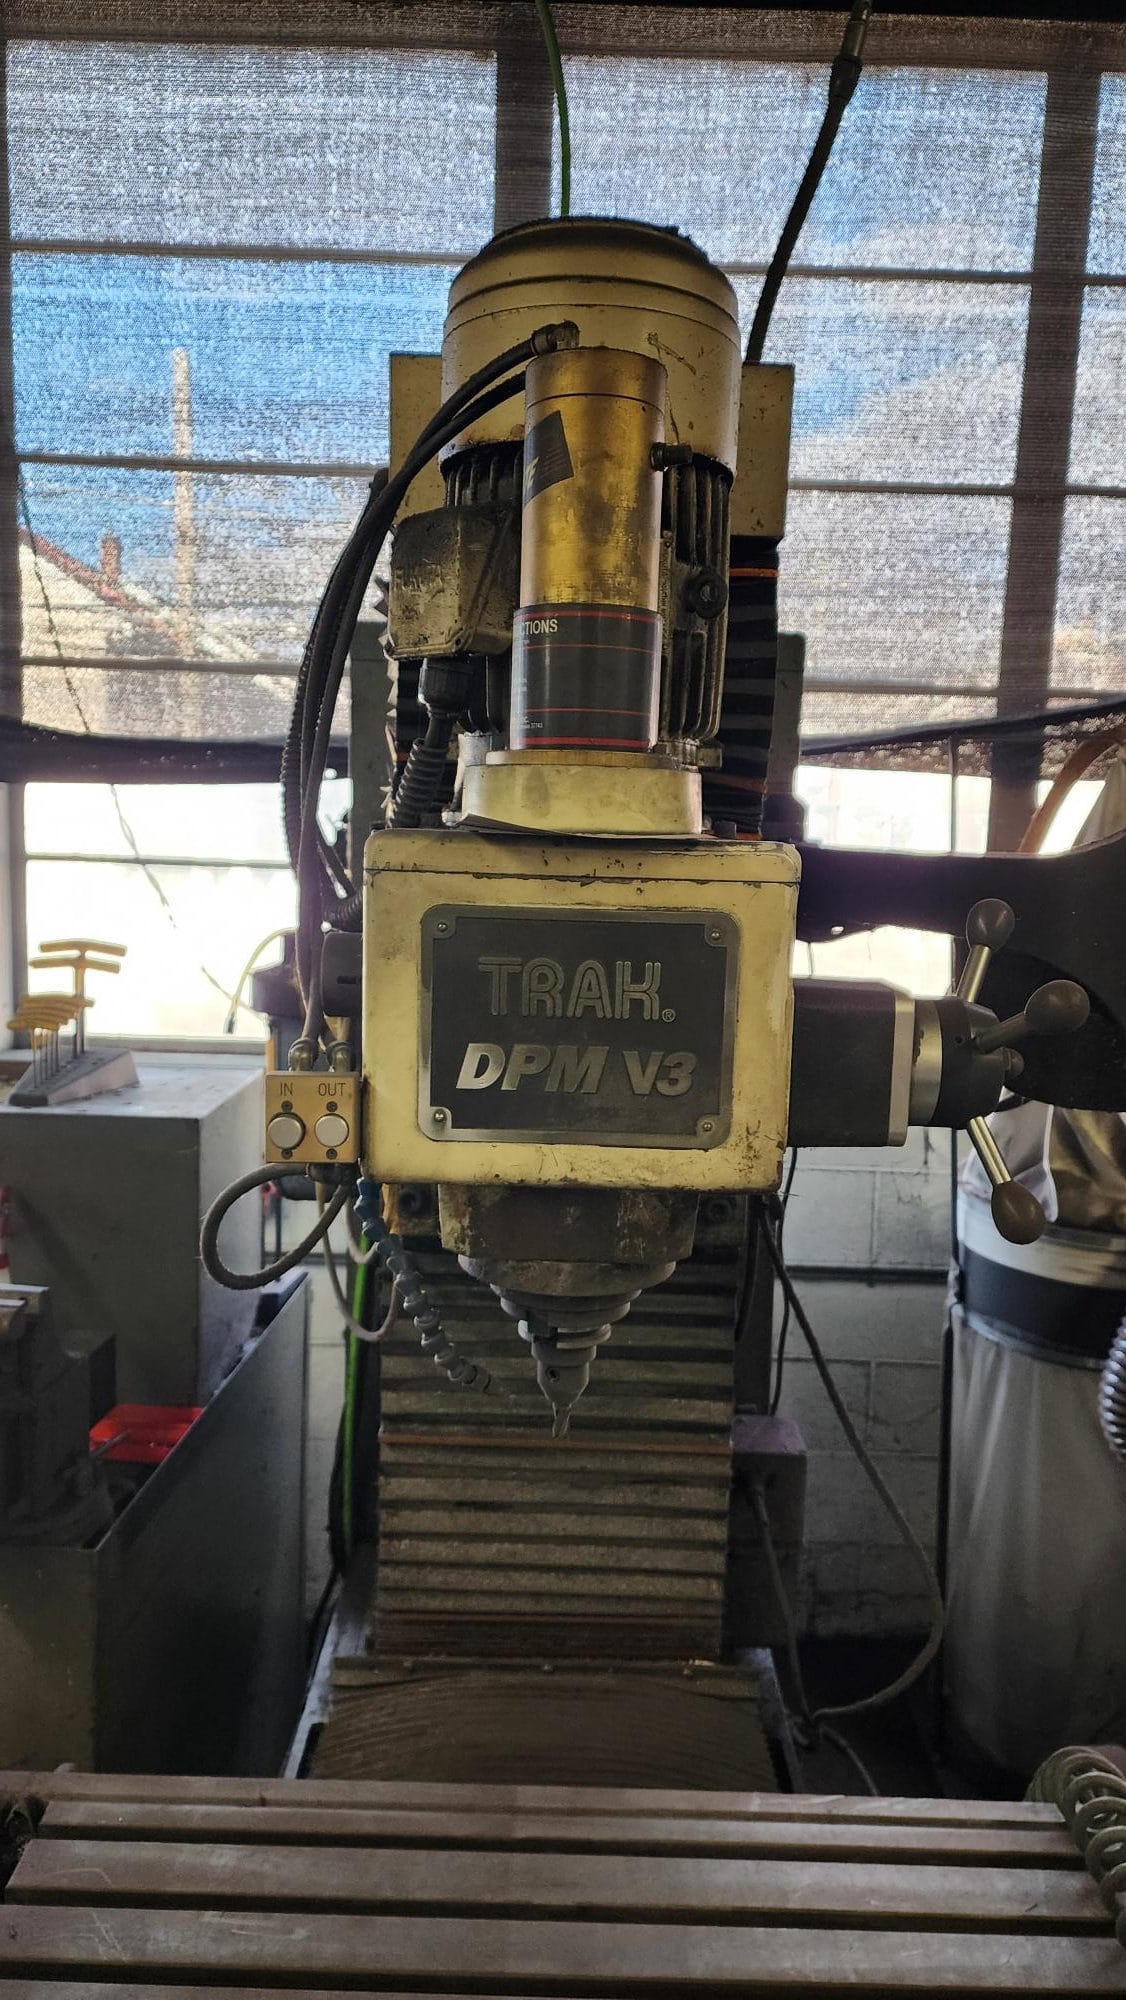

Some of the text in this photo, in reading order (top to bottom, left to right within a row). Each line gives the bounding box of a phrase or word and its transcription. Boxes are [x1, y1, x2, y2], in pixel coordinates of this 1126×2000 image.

[456, 1042, 698, 1097] DPM V3
[280, 1082, 294, 1096] IN
[318, 1082, 346, 1097] OUT
